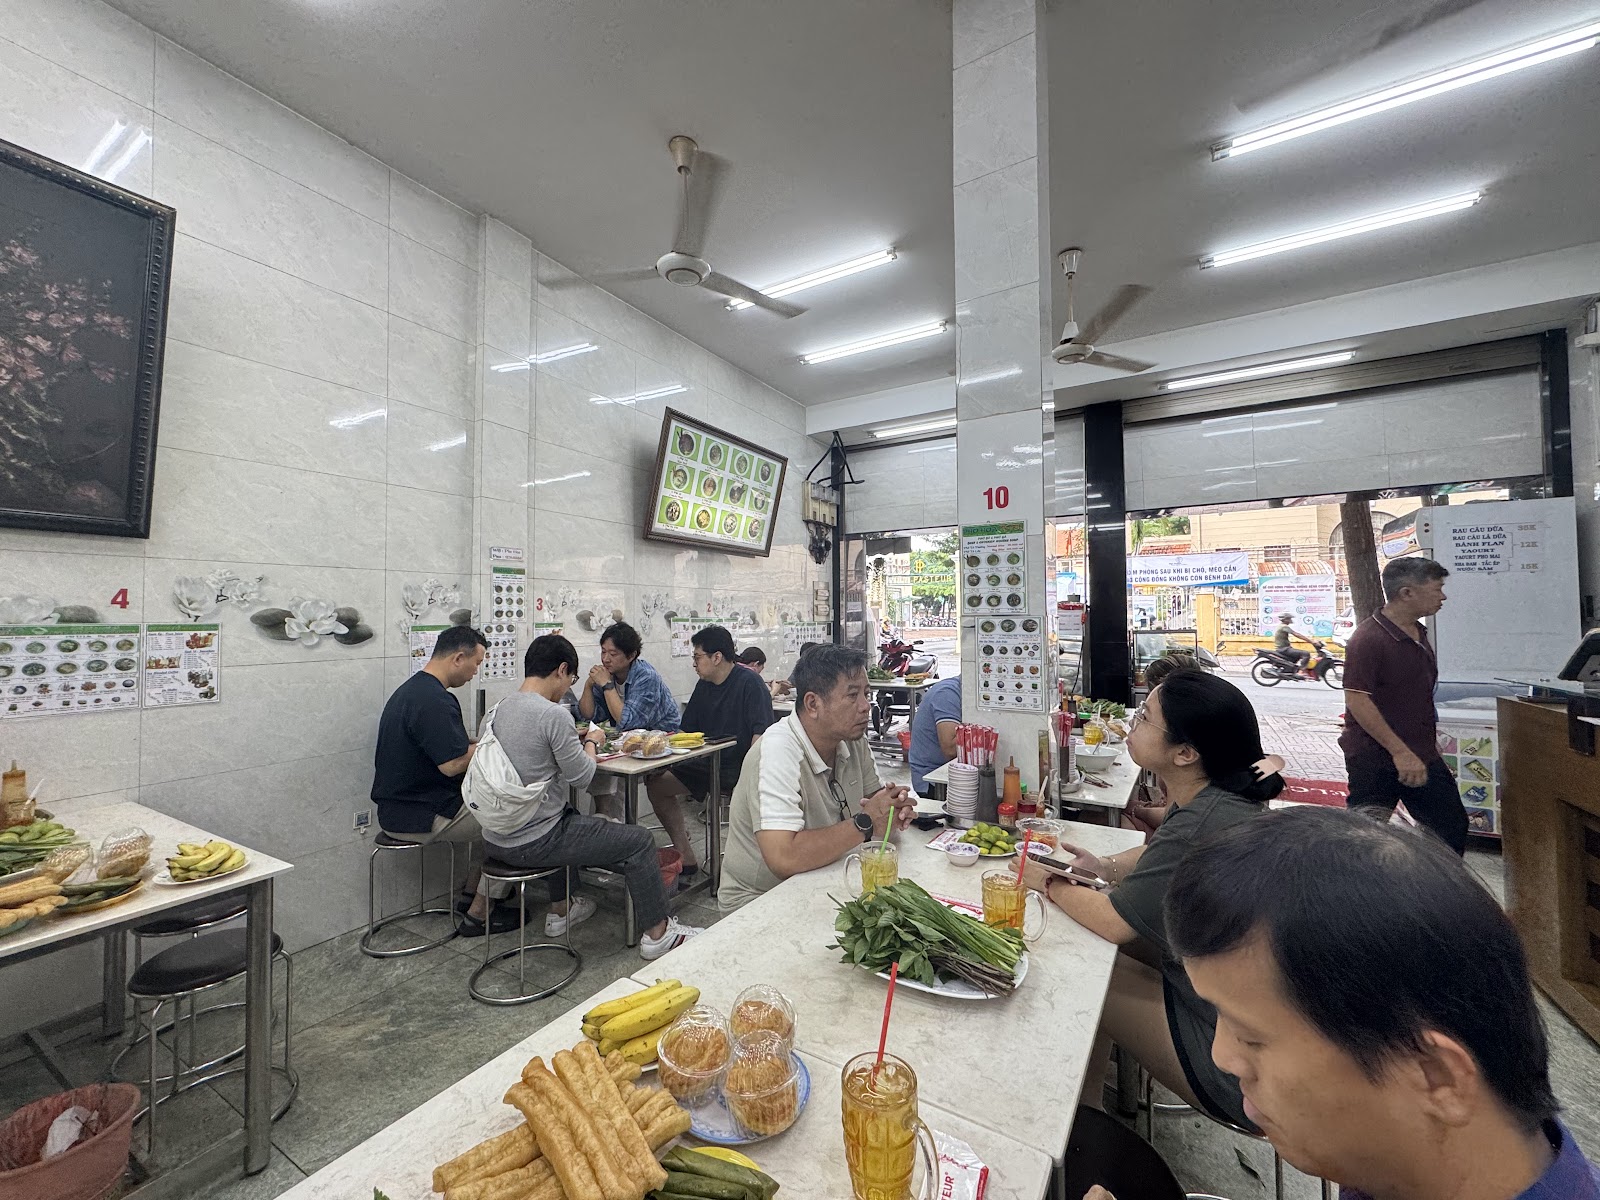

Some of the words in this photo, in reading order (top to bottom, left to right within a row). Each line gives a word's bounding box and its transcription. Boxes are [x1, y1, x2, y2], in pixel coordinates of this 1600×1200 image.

[983, 486, 1009, 510] 10
[913, 575, 953, 583] PASTEUR
[111, 588, 129, 609] 4
[536, 597, 543, 611] 3
[707, 603, 711, 613] 2
